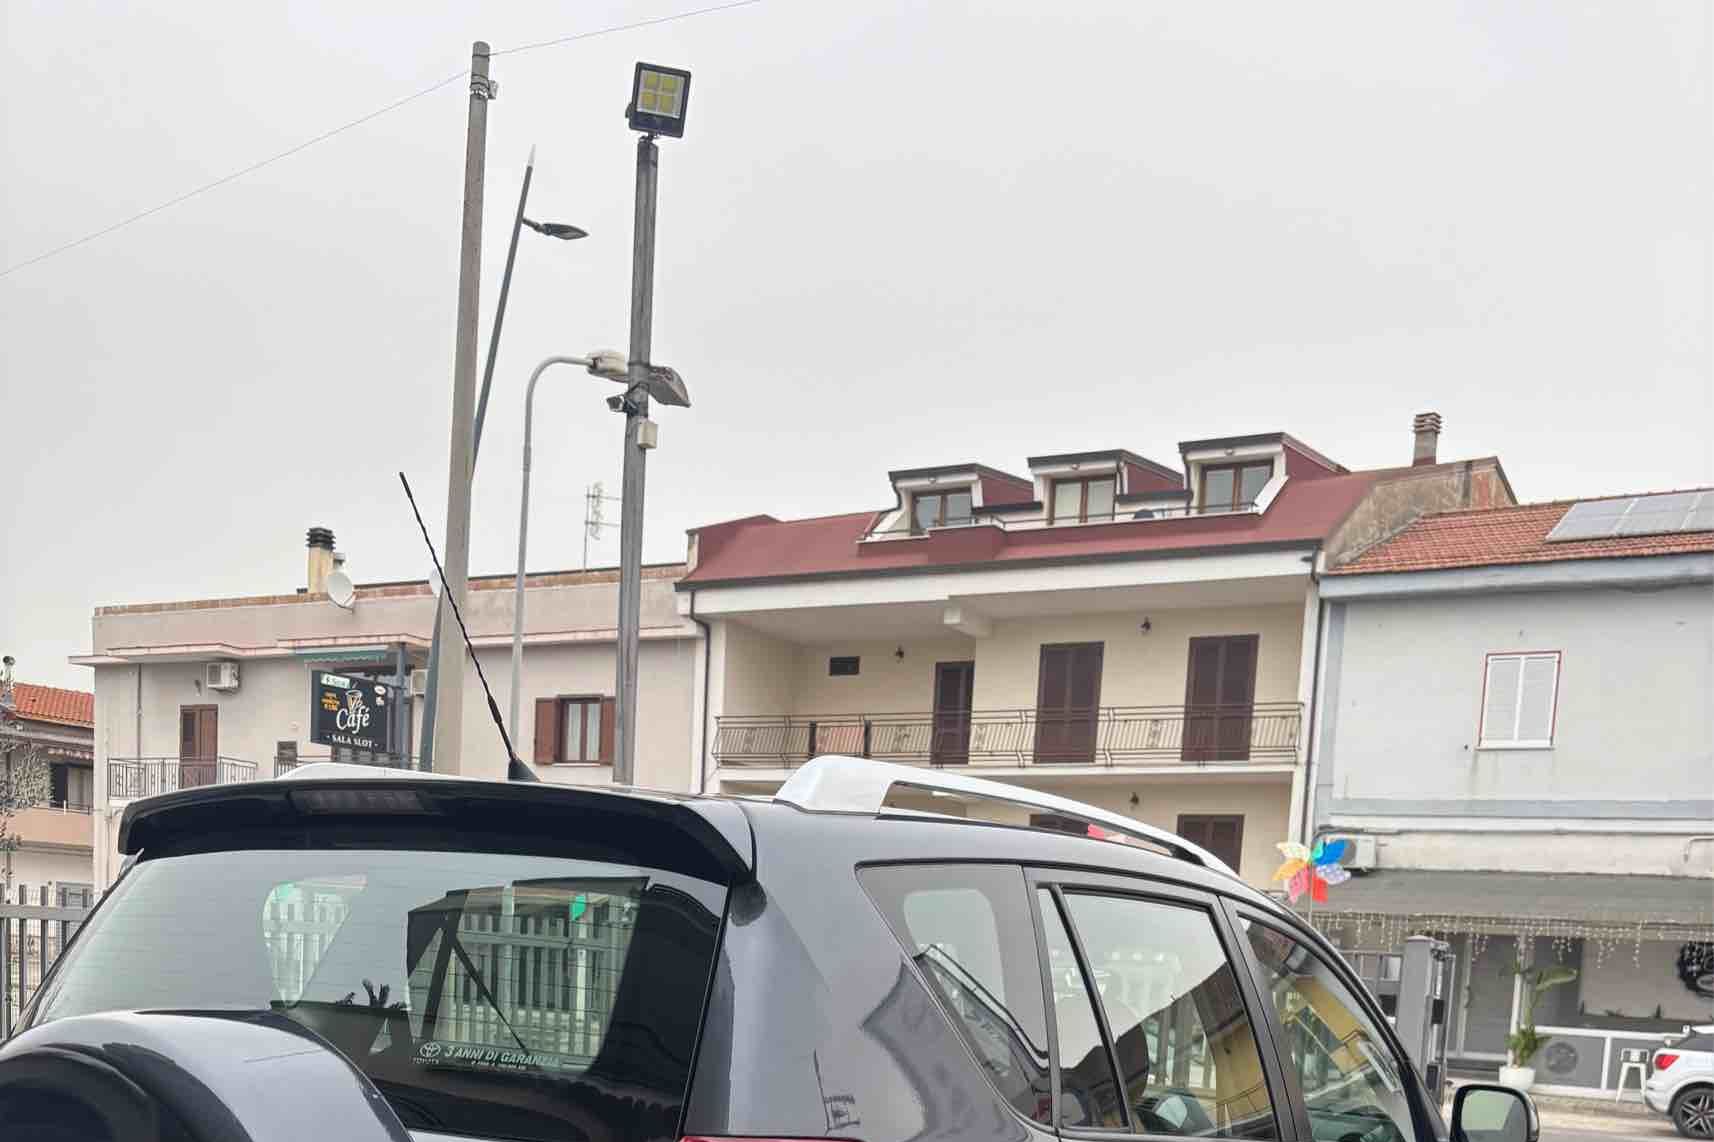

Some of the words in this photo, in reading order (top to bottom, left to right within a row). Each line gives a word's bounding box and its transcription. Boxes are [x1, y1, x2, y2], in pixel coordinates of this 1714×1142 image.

[336, 706, 370, 734] Café
[332, 735, 352, 746] SALA
[354, 738, 372, 748] SLOT
[444, 1046, 455, 1058] 3
[454, 1047, 483, 1060] ANNI
[485, 1048, 498, 1062] DI
